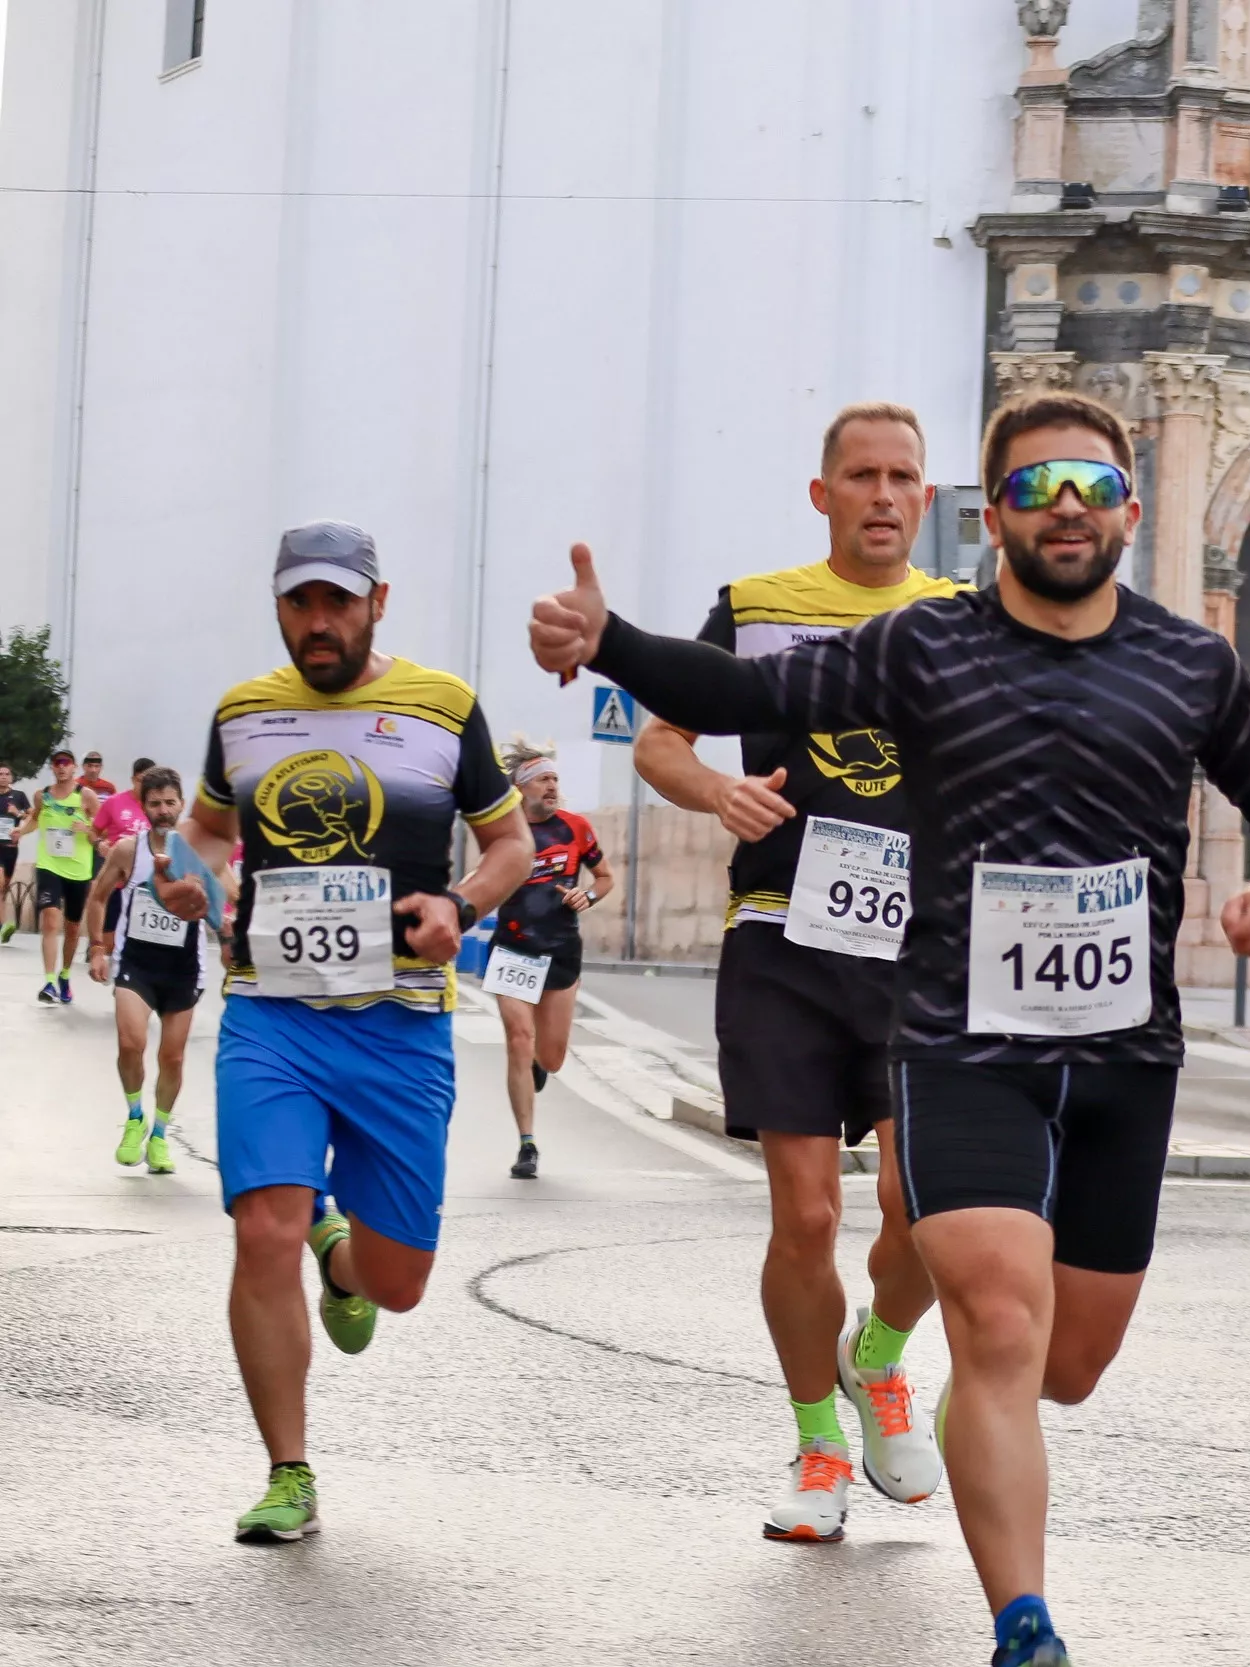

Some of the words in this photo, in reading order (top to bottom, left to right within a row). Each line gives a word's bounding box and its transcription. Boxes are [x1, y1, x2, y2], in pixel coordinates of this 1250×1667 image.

[276, 752, 328, 780] ATLETISMO
[856, 780, 886, 792] RUTE
[302, 847, 330, 860] RUTE
[1077, 871, 1118, 892] 2024
[827, 880, 906, 928] 936
[140, 911, 180, 932] 1308
[280, 925, 360, 964] 939
[1002, 936, 1132, 992] 1405
[496, 966, 537, 990] 1506
